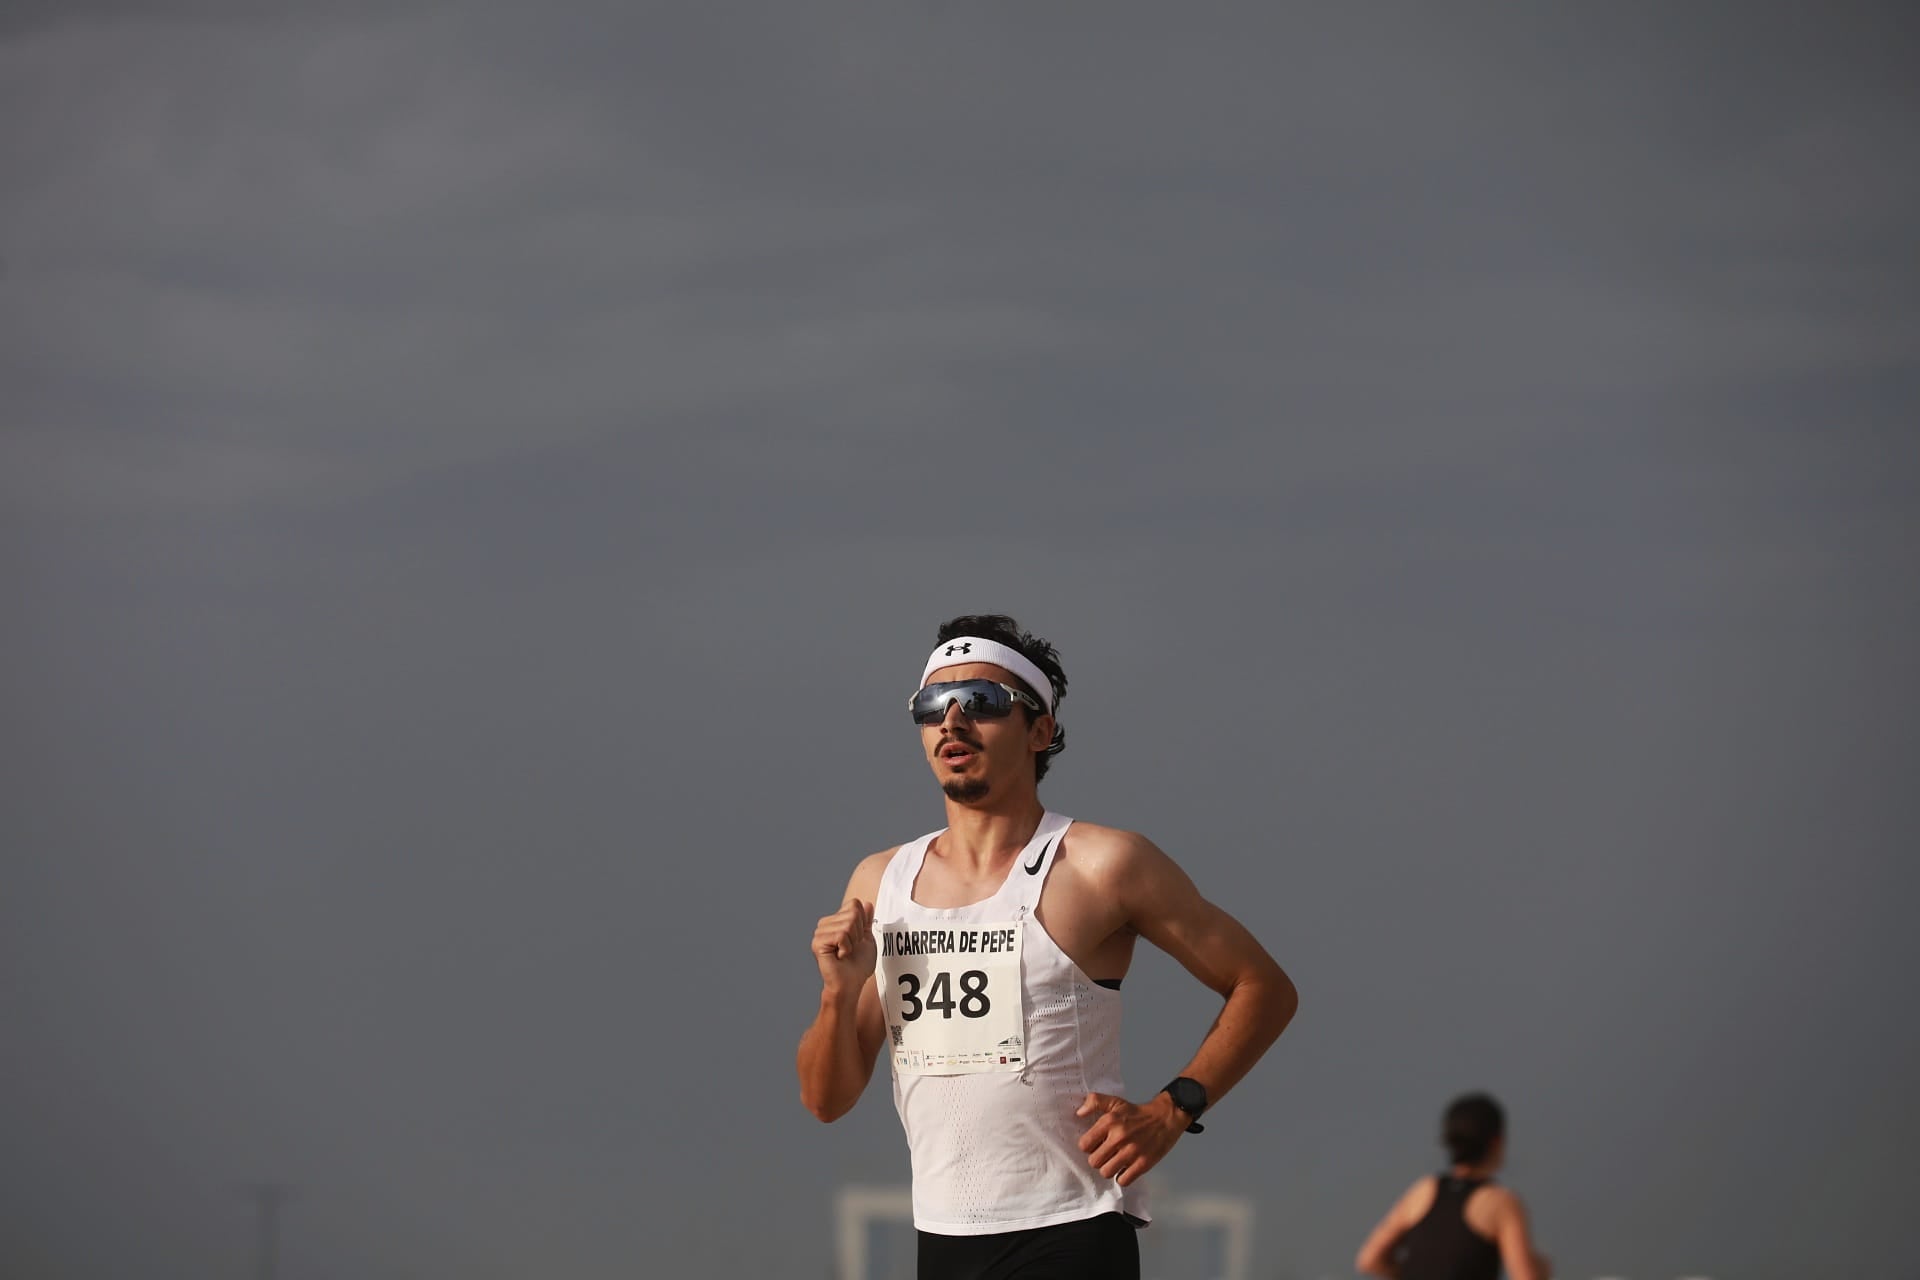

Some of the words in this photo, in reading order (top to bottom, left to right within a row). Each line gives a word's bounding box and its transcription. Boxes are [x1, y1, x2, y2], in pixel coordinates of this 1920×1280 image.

[896, 930, 955, 956] CARRERA
[959, 931, 978, 953] DE
[981, 929, 1015, 953] PEPE
[898, 969, 991, 1022] 348
